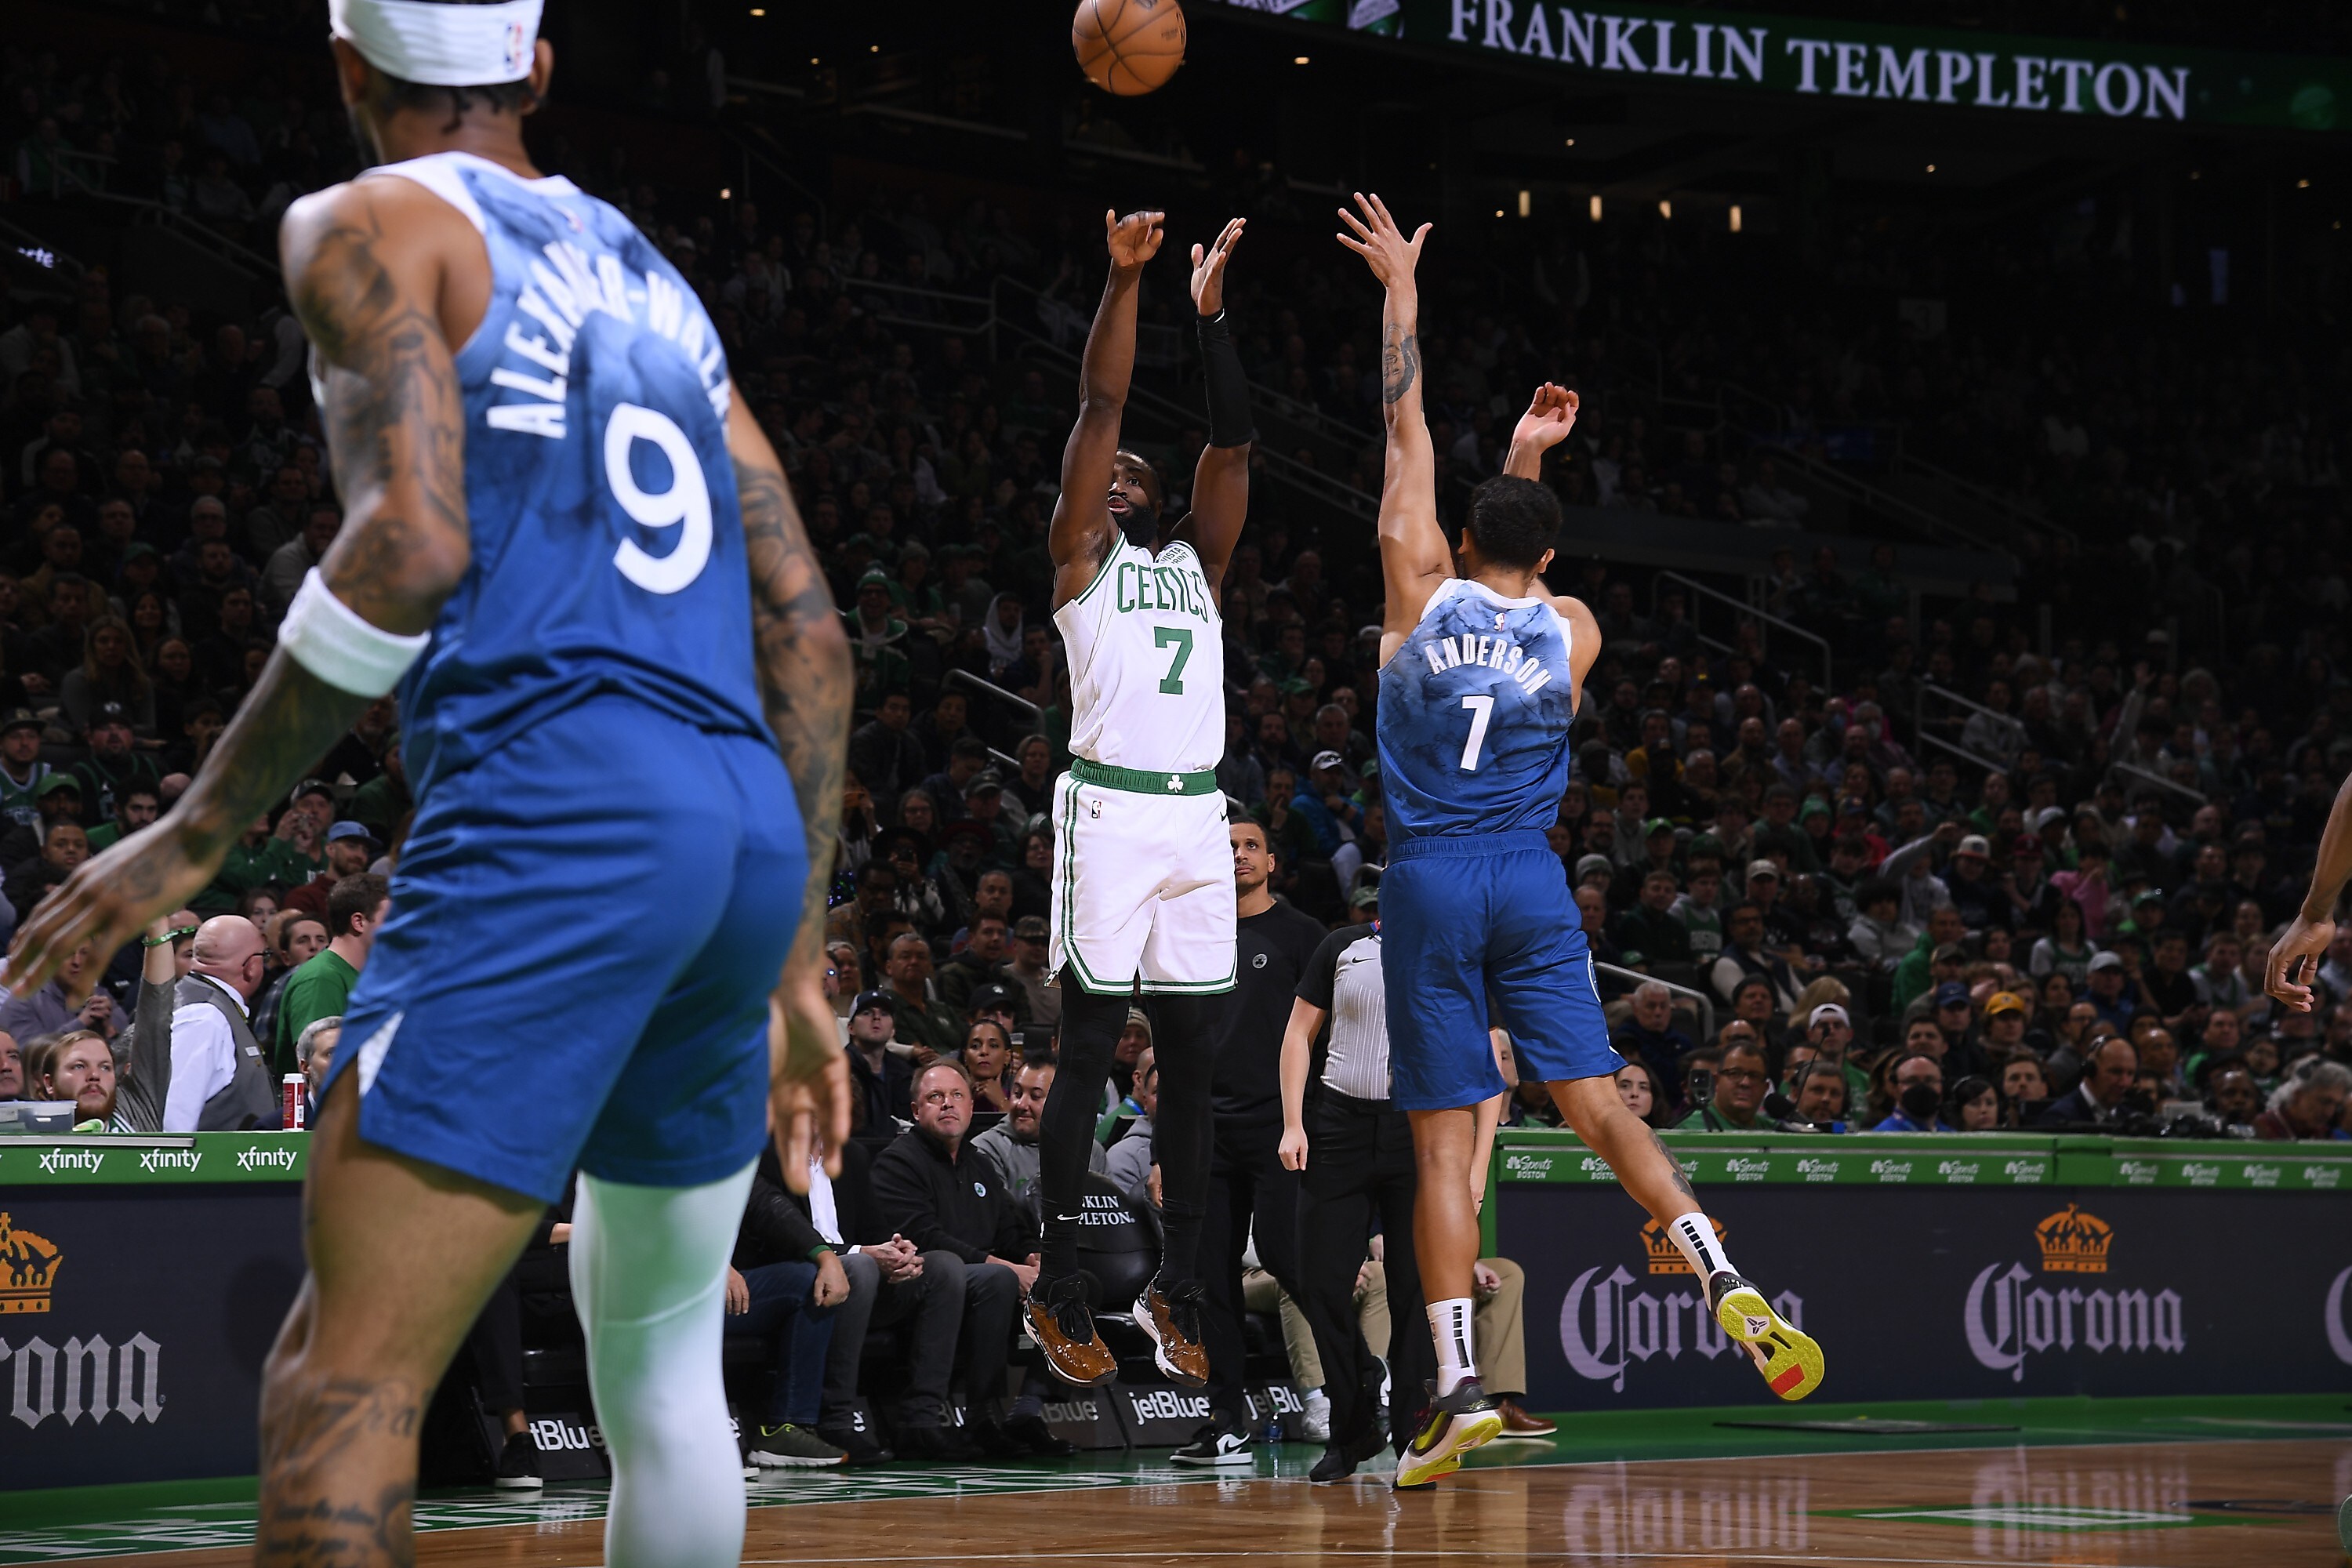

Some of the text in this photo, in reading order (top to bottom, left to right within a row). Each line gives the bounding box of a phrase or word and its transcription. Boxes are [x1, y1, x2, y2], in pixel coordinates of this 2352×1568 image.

[1448, 0, 2190, 121] FRANKLIN TEMPLETON
[604, 402, 713, 595] 9
[1160, 547, 1184, 562] VISTA
[1117, 561, 1208, 624] CELTICS
[1153, 626, 1193, 695] 7
[1425, 633, 1552, 695] ANDERSON
[1460, 695, 1495, 771] 7
[39, 1148, 104, 1174] xfinity
[140, 1148, 202, 1173] xfinity
[237, 1146, 297, 1171] xfinity
[1516, 1171, 1547, 1179] BOSTON
[1521, 1156, 1553, 1171] Sports
[1082, 1196, 1119, 1208] KLIN
[1559, 1264, 1803, 1394] Coroa
[1964, 1261, 2186, 1382] Corona
[0, 1331, 165, 1429] ona
[1040, 1400, 1098, 1424] Blue
[1128, 1391, 1211, 1425] jetBlue
[528, 1419, 605, 1450] tBlue
